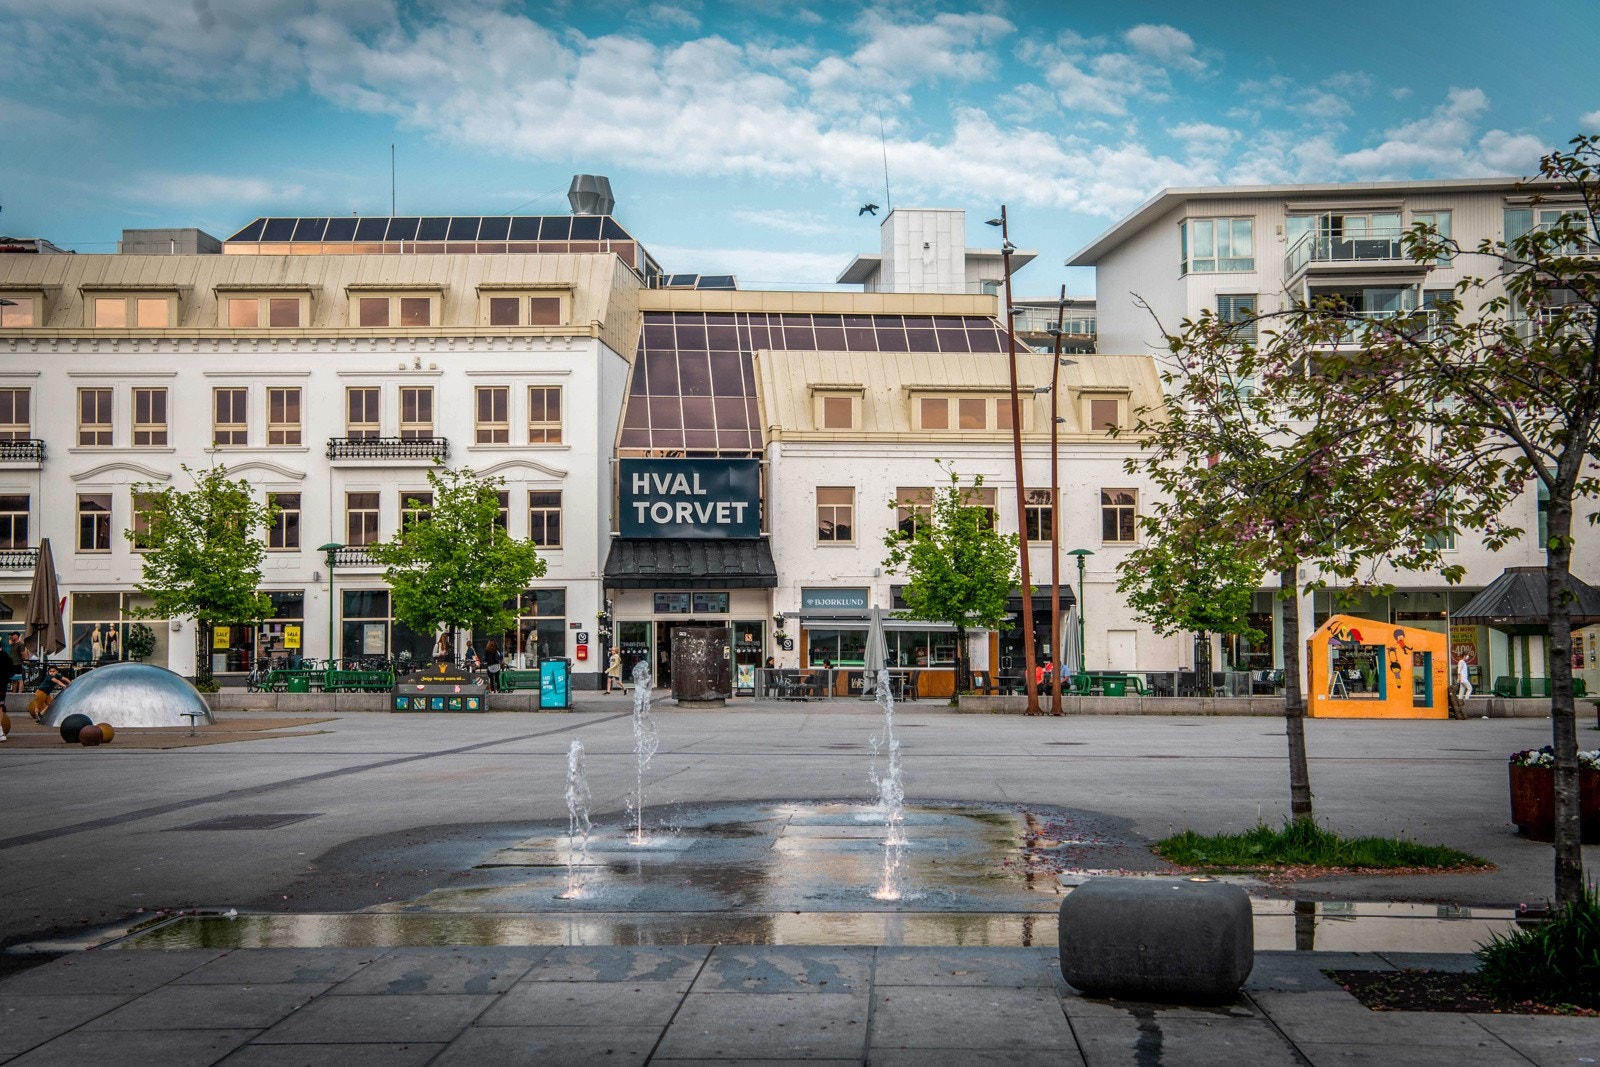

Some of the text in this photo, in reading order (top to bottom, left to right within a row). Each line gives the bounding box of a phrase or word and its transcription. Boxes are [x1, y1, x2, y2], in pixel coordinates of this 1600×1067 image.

[632, 473, 707, 495] HVAL
[632, 501, 749, 524] TORVET
[814, 598, 863, 606] BJØRKLUND
